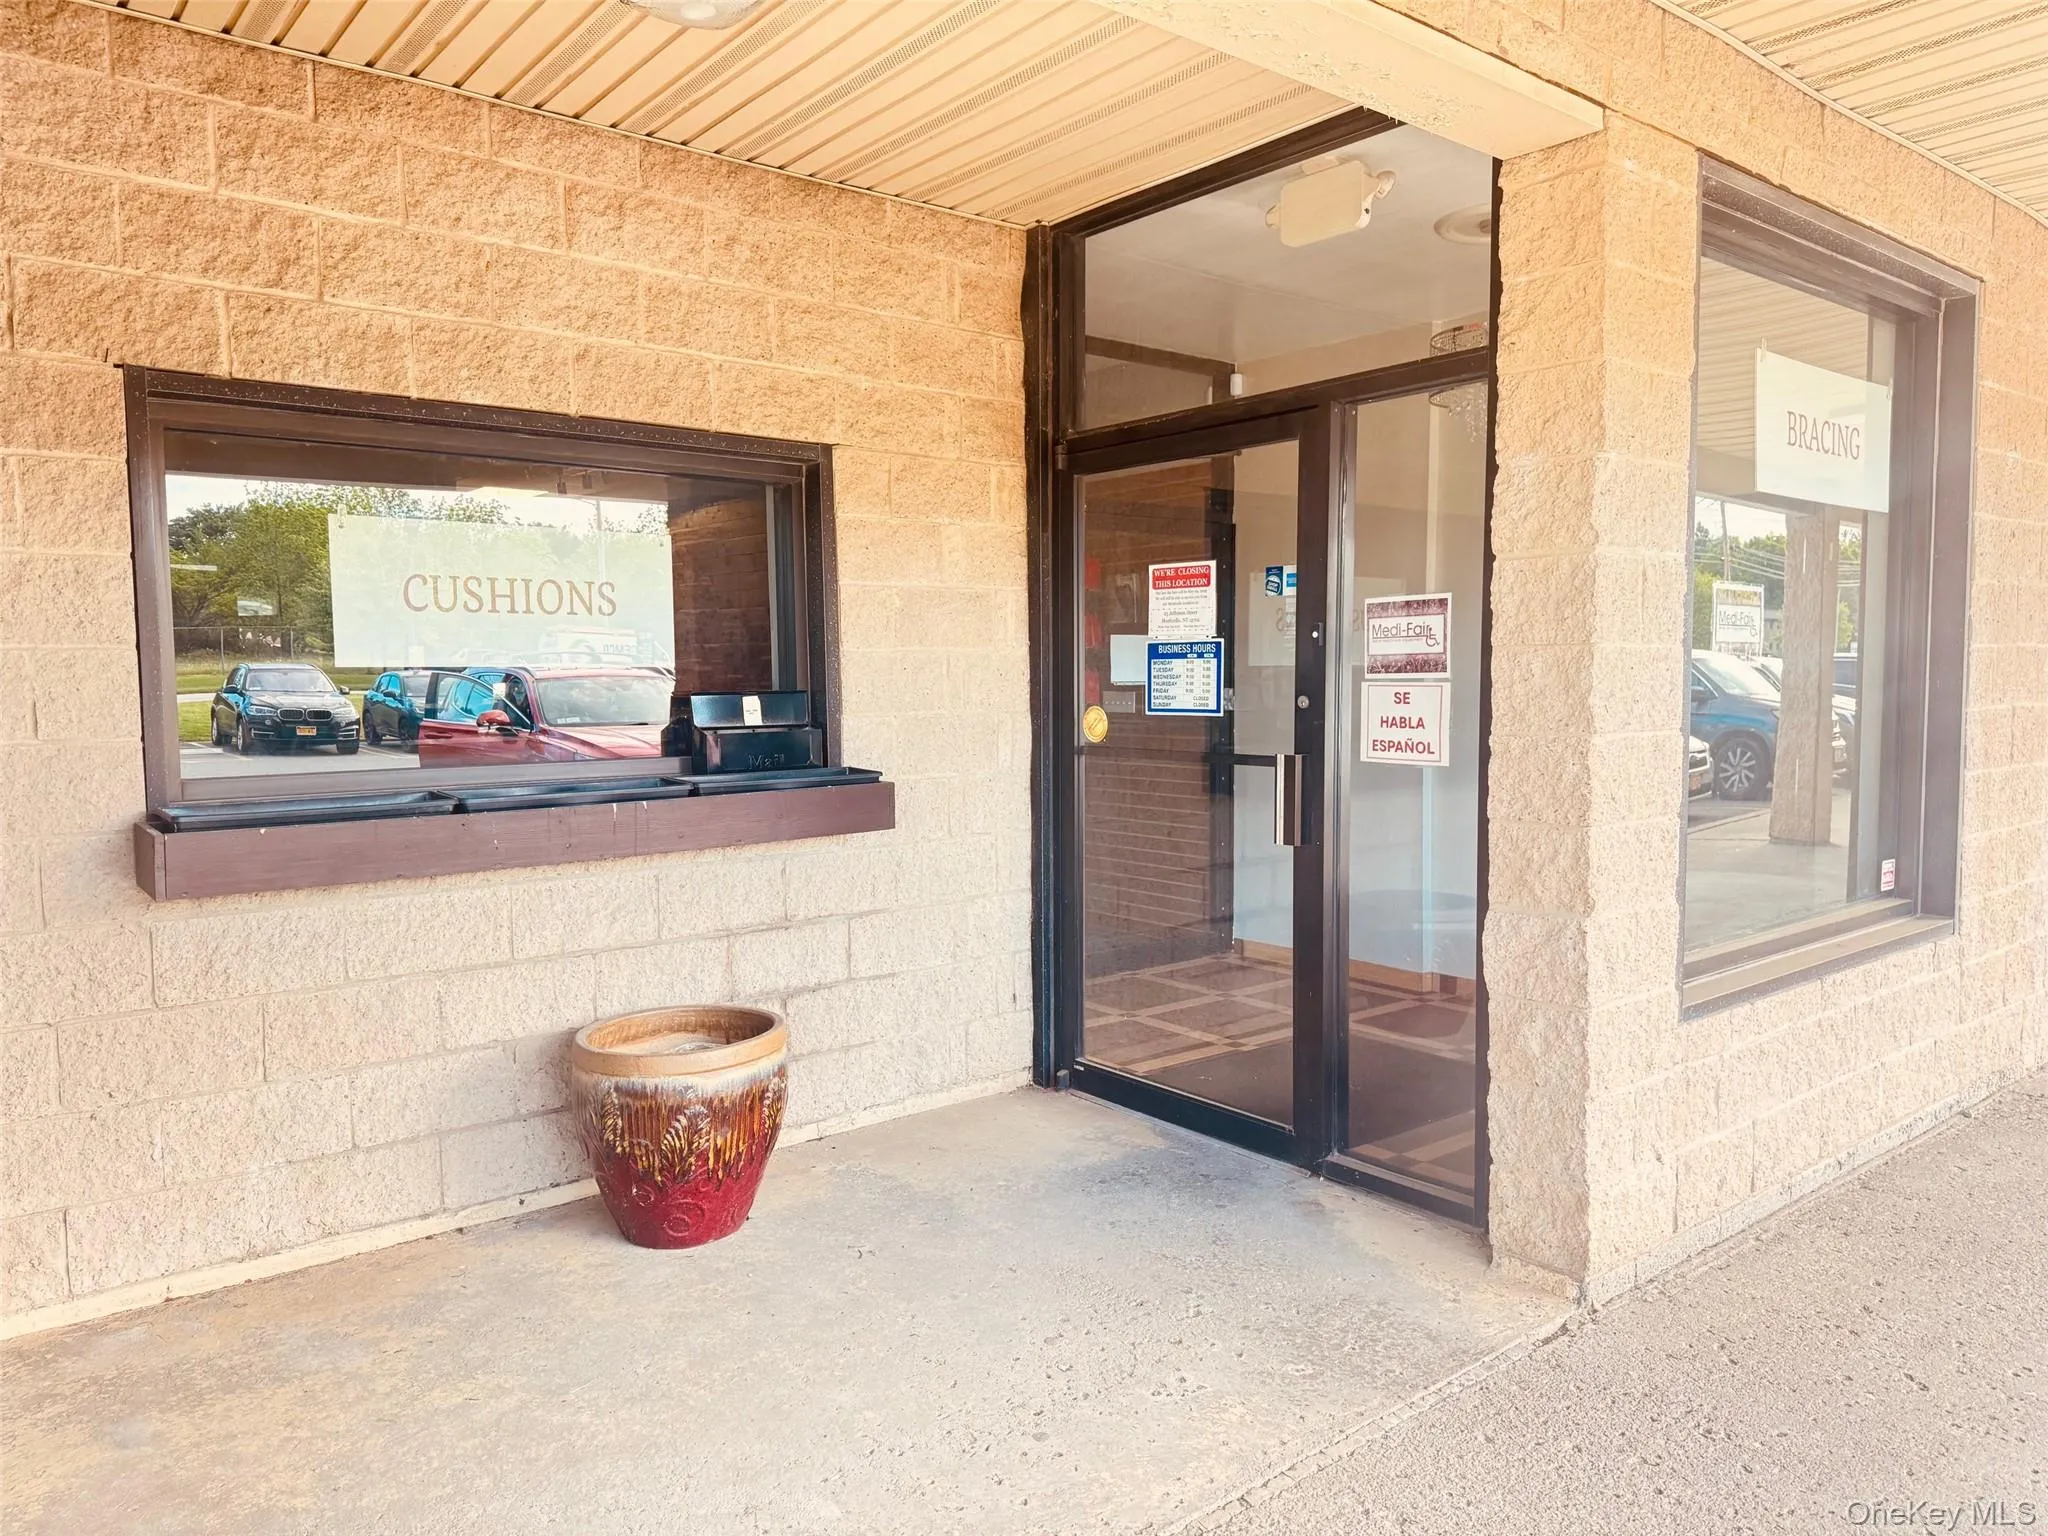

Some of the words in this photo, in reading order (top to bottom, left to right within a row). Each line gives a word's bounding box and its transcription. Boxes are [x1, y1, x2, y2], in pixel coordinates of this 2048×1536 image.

[1787, 410, 1860, 460] BRACING
[1154, 569, 1176, 577] WE'RE
[1178, 566, 1209, 575] CLOSING
[1155, 580, 1171, 588] THIS
[1173, 578, 1208, 587] LOCATION
[403, 573, 617, 616] CUSHIONS
[1372, 622, 1430, 637] Medi-Fair
[1158, 645, 1191, 654] BUSINESS
[1192, 643, 1216, 653] HOURS
[1393, 692, 1411, 704] SE
[1380, 716, 1425, 729] HABLA
[1372, 738, 1435, 754] ESPAÑOL
